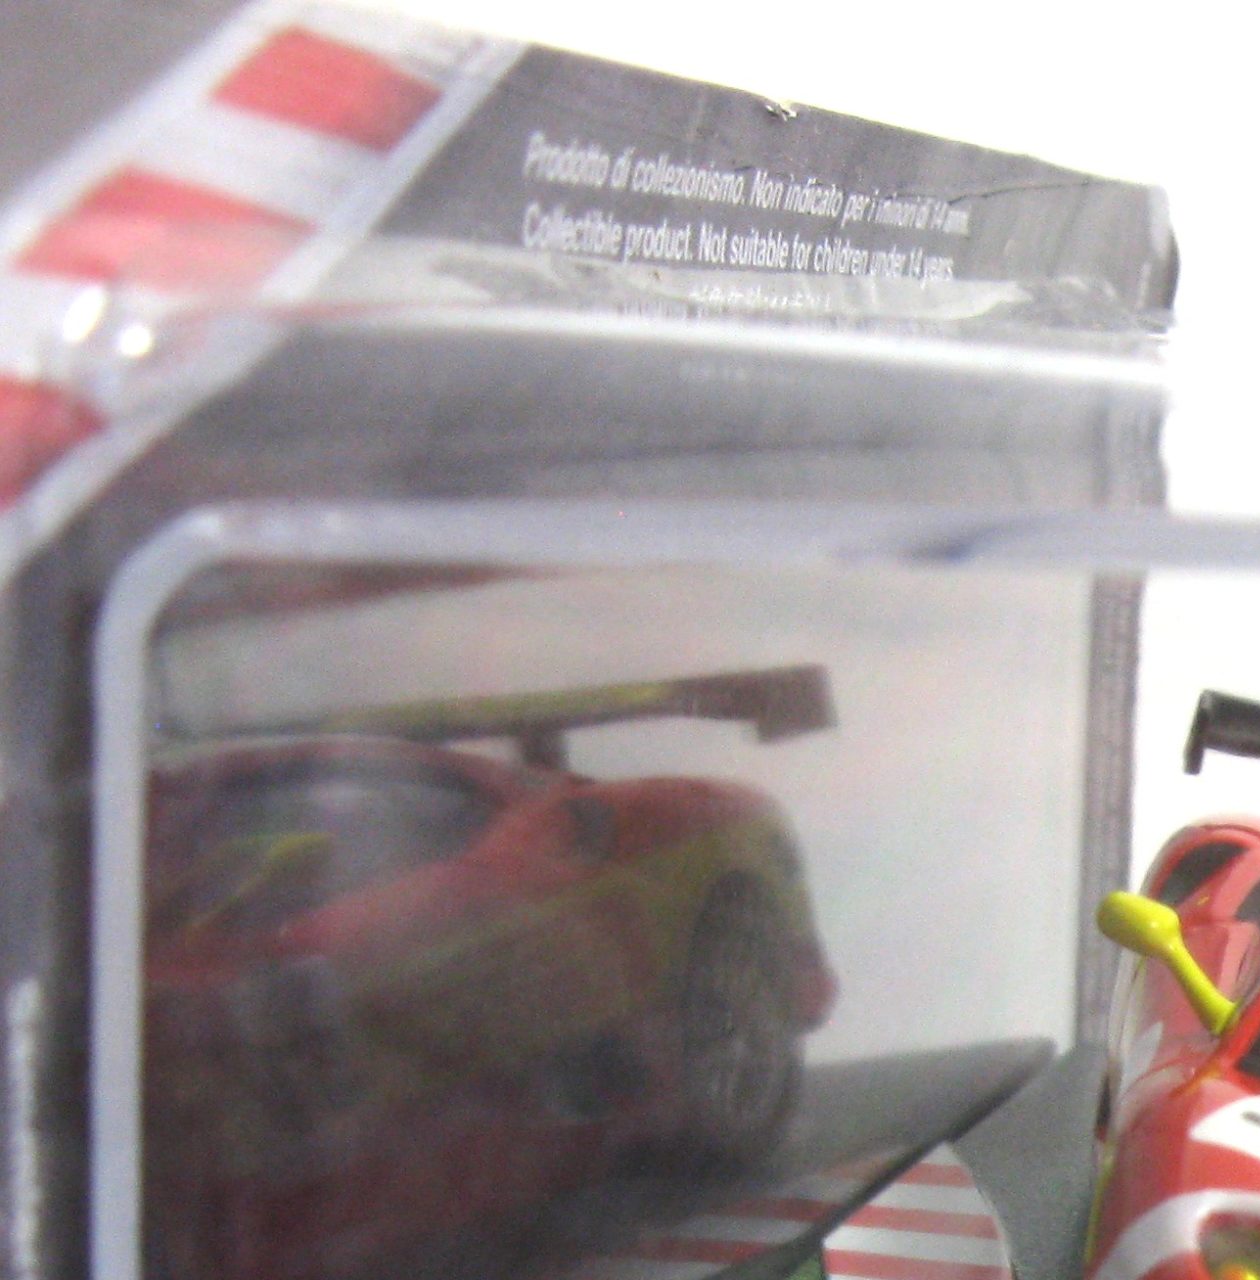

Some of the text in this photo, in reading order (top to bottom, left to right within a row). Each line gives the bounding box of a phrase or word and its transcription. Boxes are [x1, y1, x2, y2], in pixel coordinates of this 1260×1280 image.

[524, 131, 610, 188] Prodotto
[611, 146, 636, 190] di
[632, 152, 745, 206] collezionismo.
[751, 167, 785, 207] Non
[784, 173, 844, 218] indicato
[841, 191, 872, 229] per
[523, 203, 623, 256] Collectible
[622, 217, 693, 262] product.
[698, 220, 729, 267] Not
[729, 226, 789, 269] suitable
[790, 231, 815, 271] for
[814, 235, 869, 275] children
